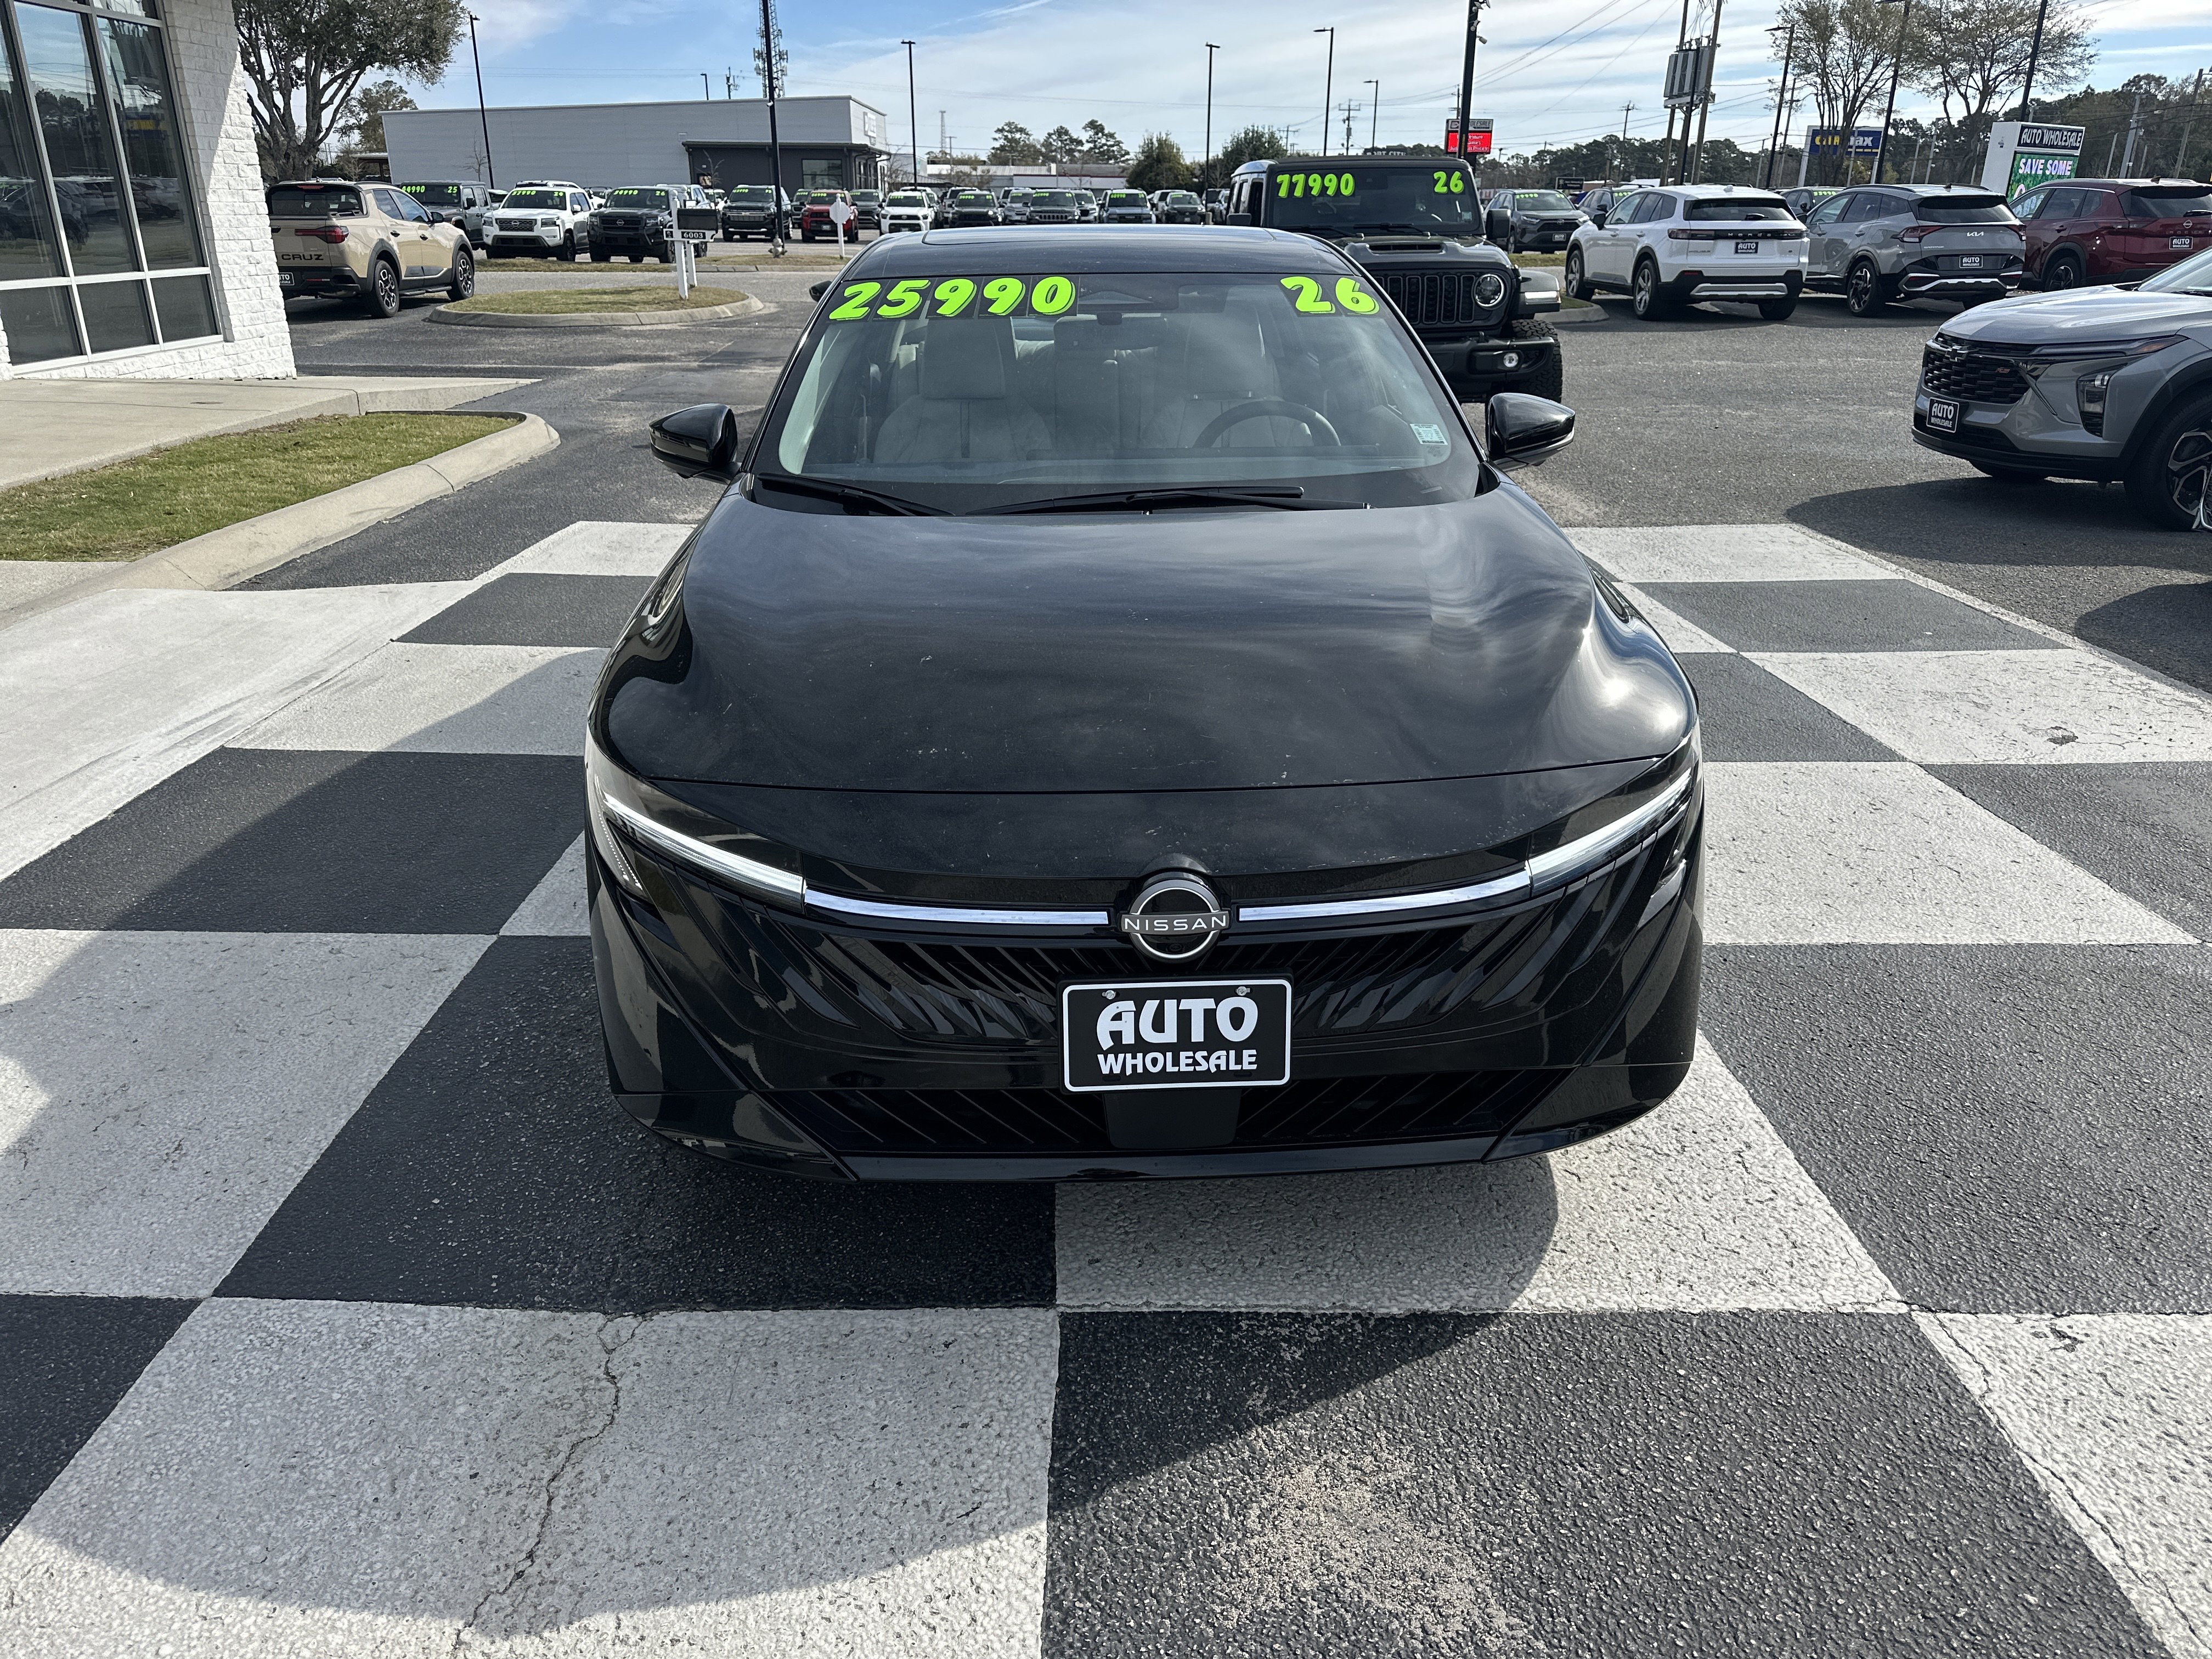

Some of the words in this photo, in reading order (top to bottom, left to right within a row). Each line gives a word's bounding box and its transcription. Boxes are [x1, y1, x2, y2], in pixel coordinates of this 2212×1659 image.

[2021, 128, 2041, 144] AUTO
[2042, 130, 2082, 147] WHOLESALE
[2019, 159, 2045, 174] SAVE
[2045, 160, 2073, 175] SOME
[1277, 173, 1355, 198] 77990
[1434, 171, 1464, 193] 26
[828, 276, 1076, 320] 25990
[1280, 276, 1380, 315] 26
[1932, 403, 1954, 419] AUTO
[1931, 416, 1953, 428] WHOLESALE
[1125, 915, 1227, 932] NISSAN
[1097, 997, 1258, 1051] AUTO
[1097, 1049, 1257, 1076] WHOLESALE
